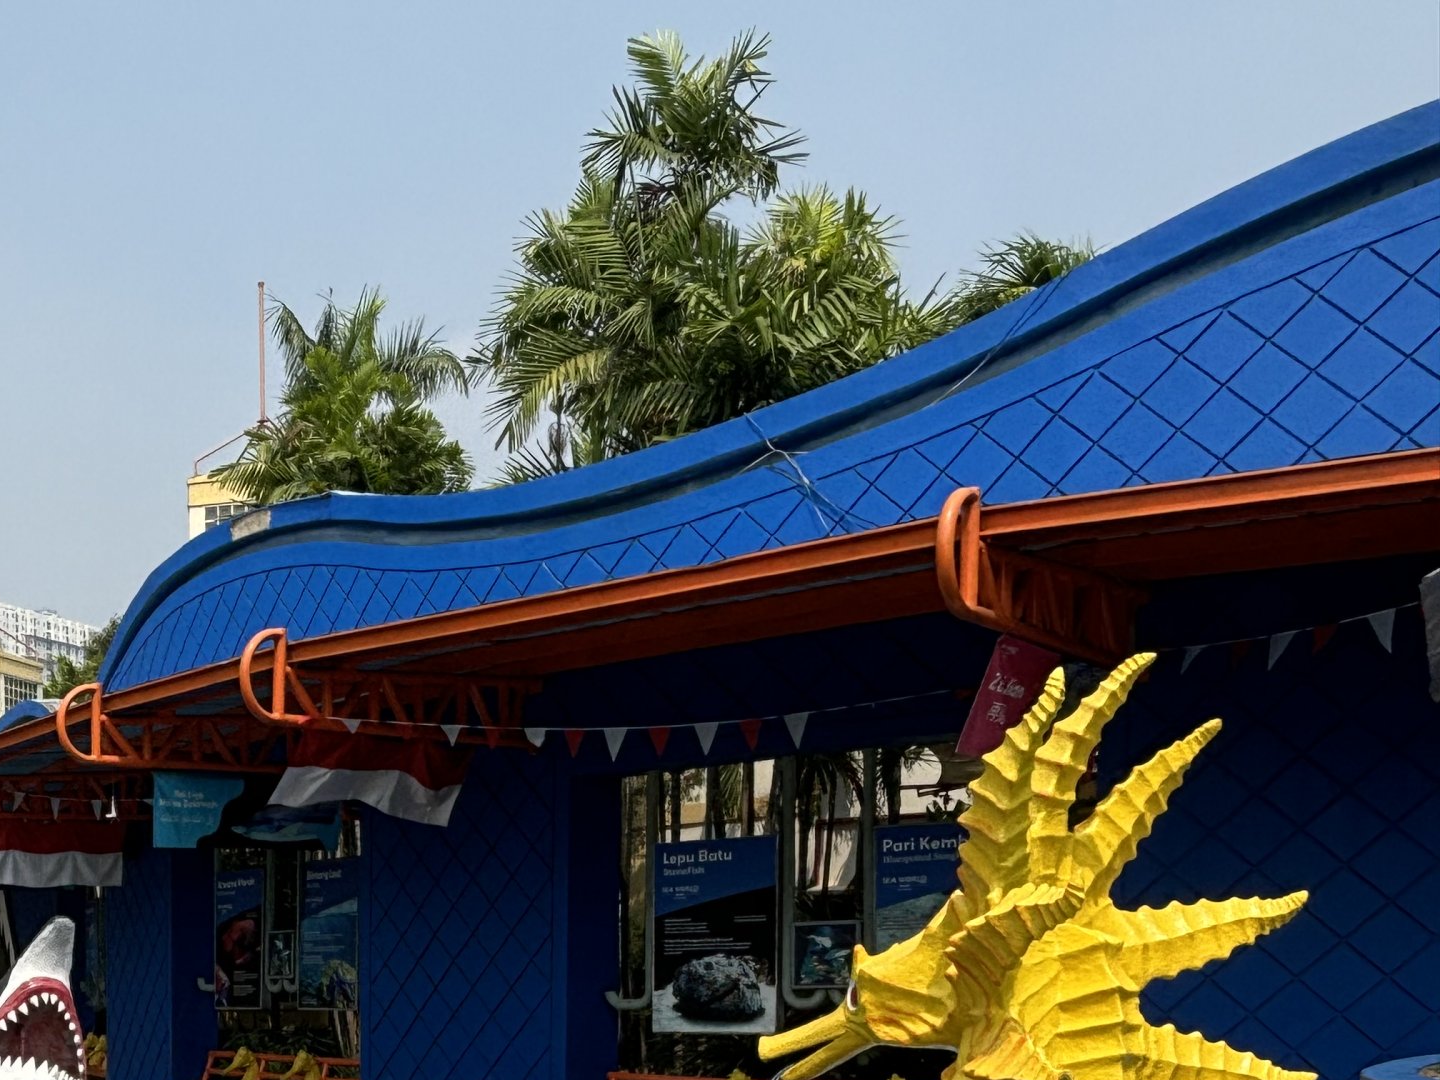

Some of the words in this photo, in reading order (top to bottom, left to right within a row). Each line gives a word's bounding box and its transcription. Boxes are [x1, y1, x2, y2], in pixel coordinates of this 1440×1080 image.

[882, 837, 915, 853] Pari
[663, 852, 695, 866] Lepu
[698, 849, 732, 862] Batu
